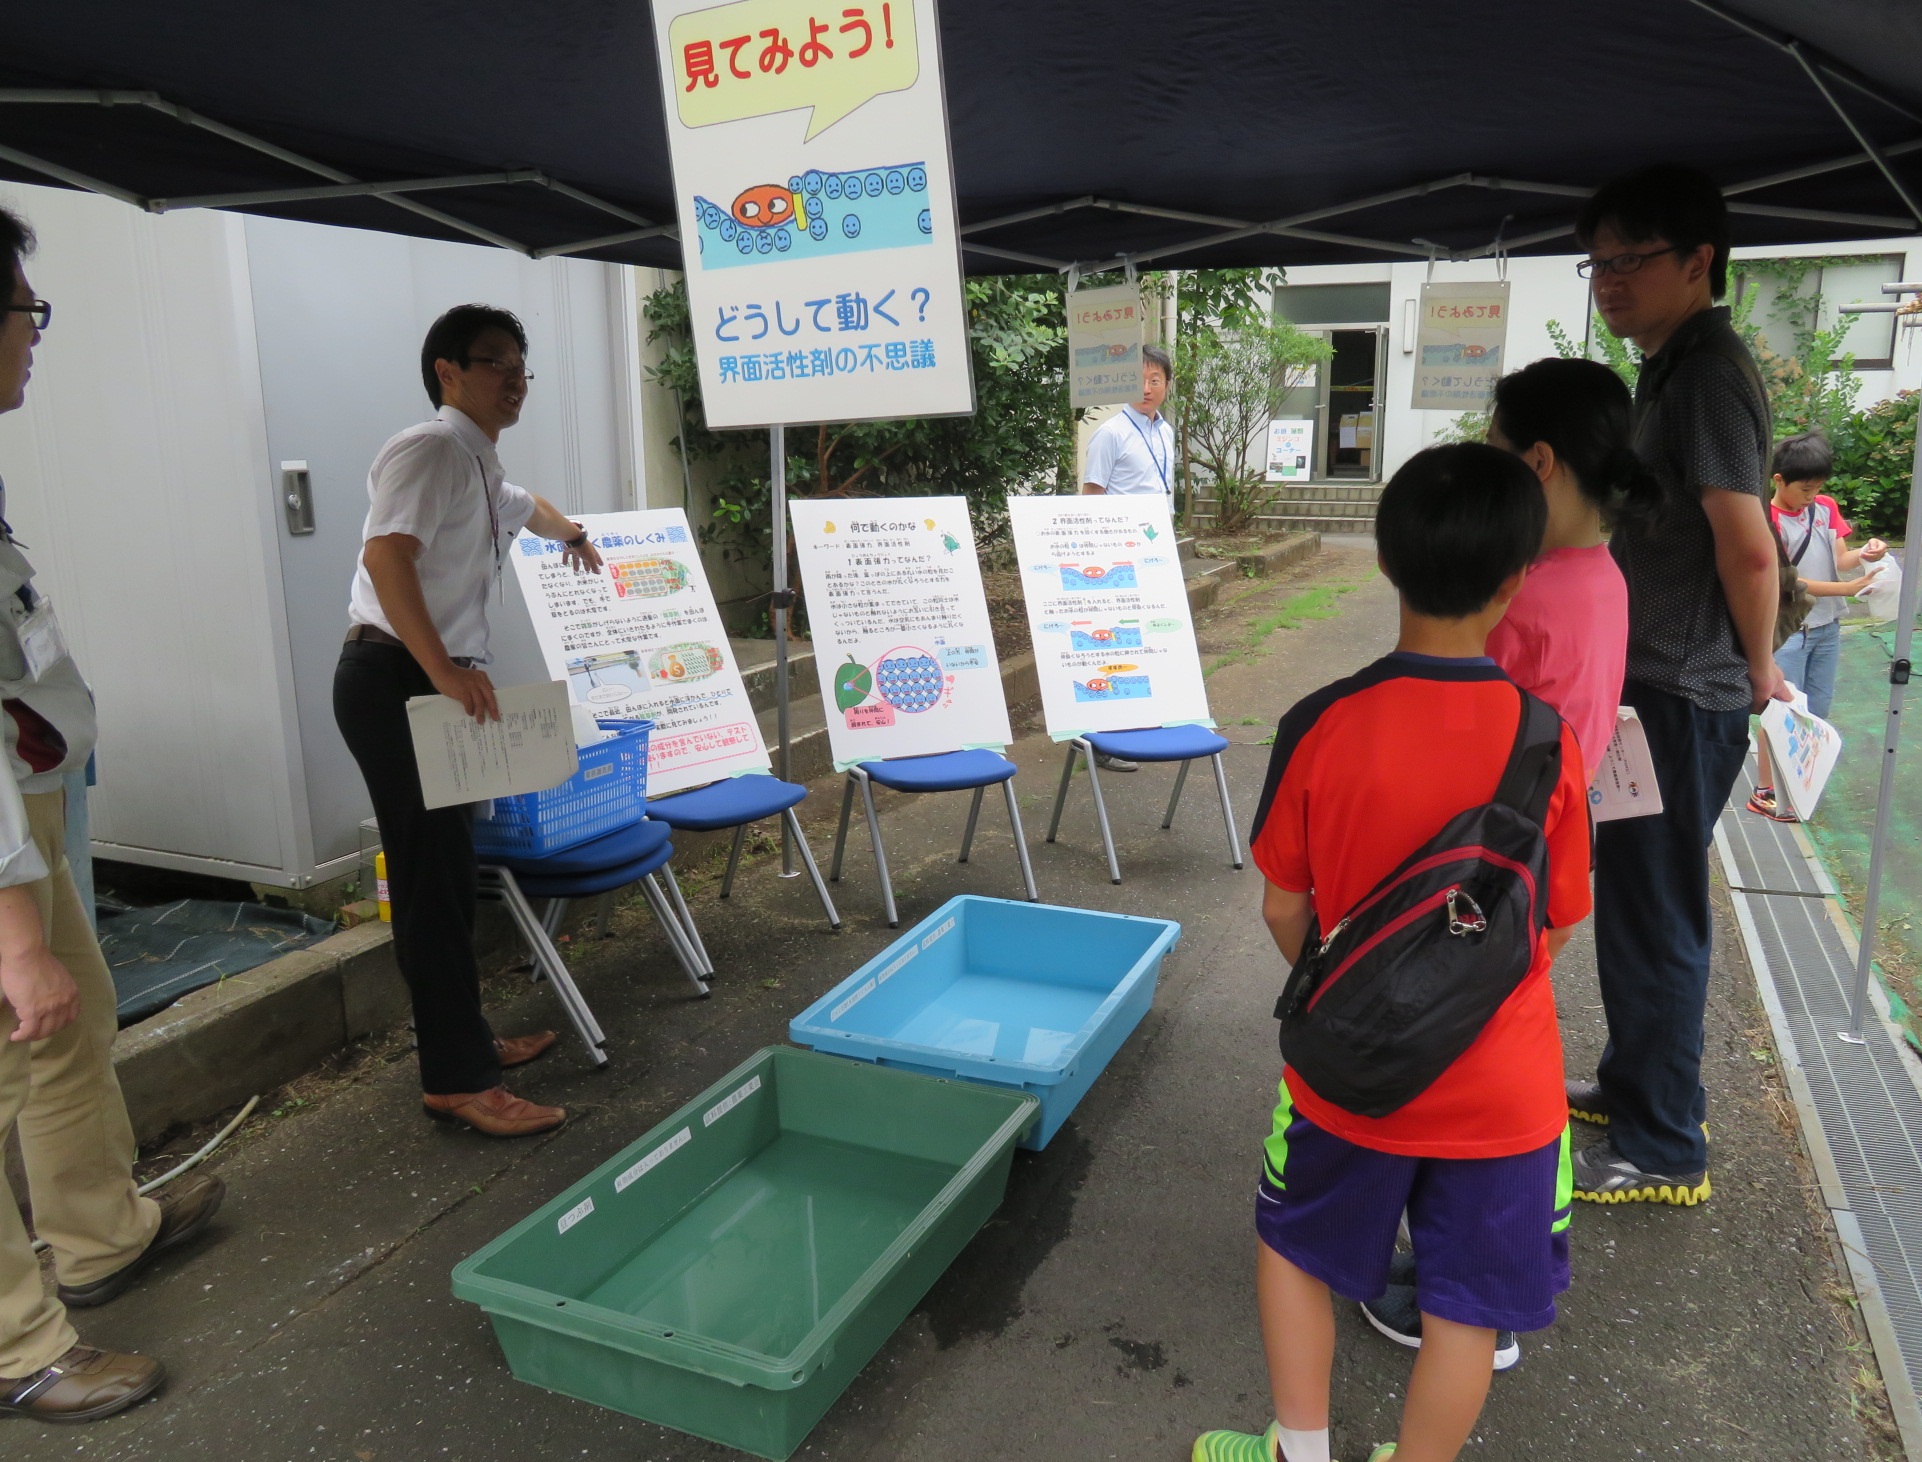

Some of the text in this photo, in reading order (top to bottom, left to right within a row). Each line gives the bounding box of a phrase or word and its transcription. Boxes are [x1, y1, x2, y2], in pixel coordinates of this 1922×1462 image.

[684, 3, 894, 92] 見てみよう！
[715, 287, 931, 343] どうして動く？
[719, 339, 936, 384] 界面活性剤の不思議
[851, 521, 917, 533] 何で動くのかな
